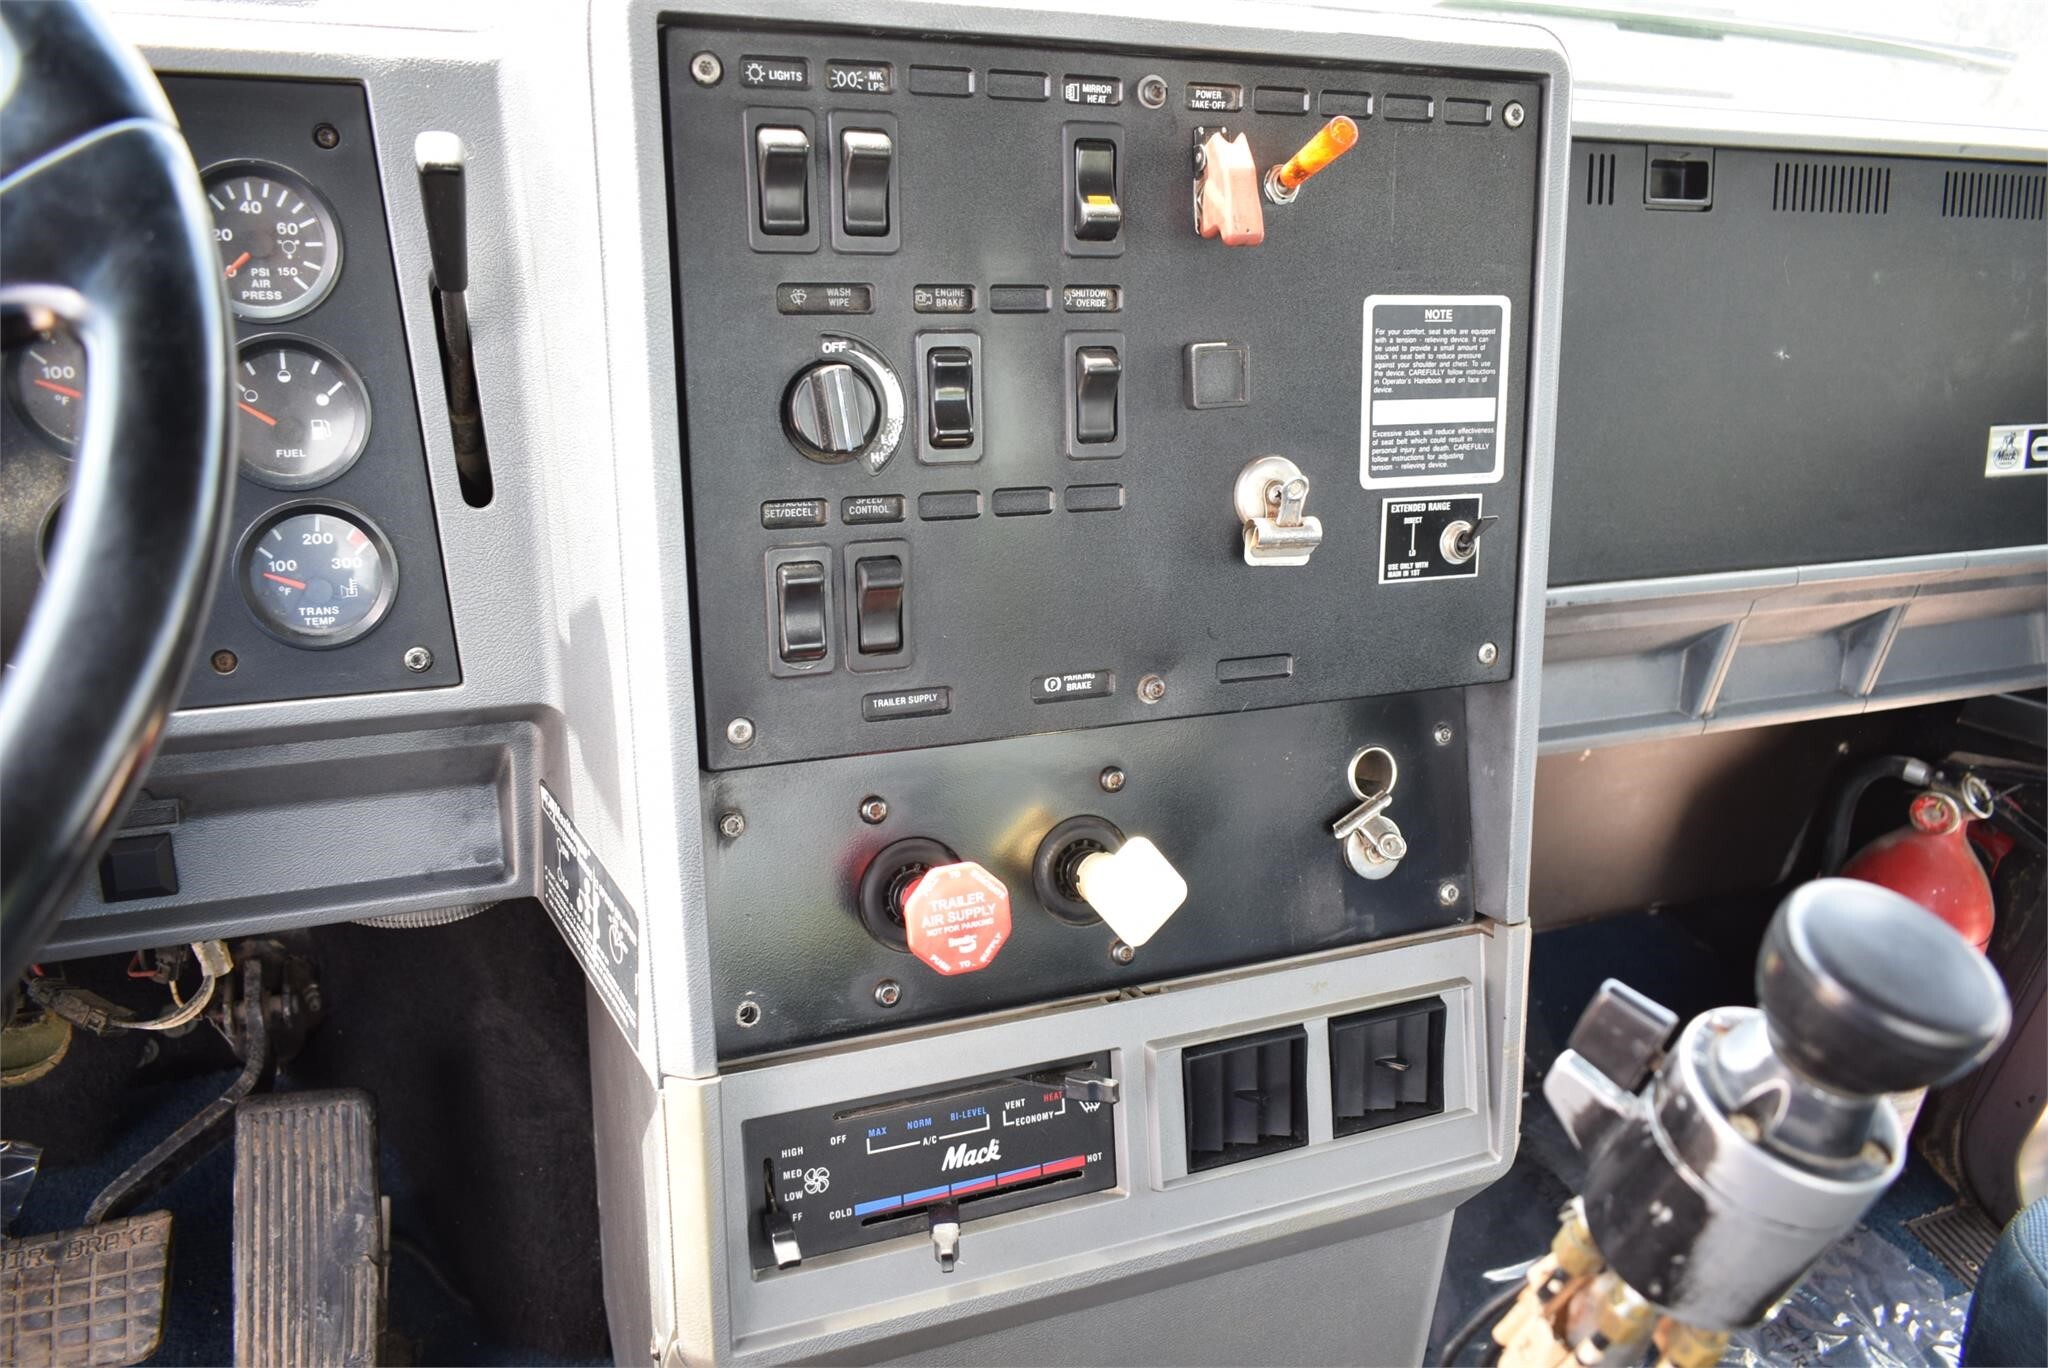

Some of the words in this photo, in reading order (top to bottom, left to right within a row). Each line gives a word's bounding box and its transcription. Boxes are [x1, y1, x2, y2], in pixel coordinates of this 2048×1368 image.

[768, 70, 803, 82] LIGHTS
[869, 71, 883, 81] MK
[868, 82, 886, 92] LPS
[1082, 84, 1112, 94] MIRROR
[1087, 94, 1107, 104] HEAT
[1196, 89, 1222, 100] POWER
[1191, 100, 1226, 110] TAKE-OFF
[239, 201, 262, 214] 40
[212, 229, 233, 241] 20
[276, 223, 298, 235] 60
[250, 268, 270, 277] PSI
[278, 267, 298, 277] 150
[252, 280, 271, 288] AIR
[242, 291, 282, 300] PRESS
[826, 288, 851, 297] WASH
[935, 289, 965, 298] ENGINE
[829, 298, 850, 307] WIPE
[936, 299, 964, 307] BRAKE
[1076, 299, 1107, 308] OVERIDE
[1425, 309, 1453, 320] NOTE
[822, 342, 847, 354] OFF
[42, 366, 75, 379] 100
[1453, 443, 1490, 451] CAREFULLY
[276, 449, 307, 458] FUEL
[849, 506, 889, 515] CONTROL
[1391, 503, 1426, 513] EXTENDED
[1428, 502, 1451, 511] RANGE
[302, 533, 334, 545] 200
[268, 560, 297, 572] 100
[331, 557, 362, 570] 300
[299, 606, 340, 616] TRANS
[304, 617, 336, 626] TEMP
[1066, 681, 1092, 691] BRAKE
[873, 697, 906, 708] TRAILER
[908, 693, 938, 704] SUPPLY
[929, 891, 985, 912] TRAILER
[922, 913, 944, 929] AIR
[948, 903, 996, 923] SUPPLY
[926, 928, 943, 937] NOT
[944, 924, 960, 934] FOR
[961, 918, 994, 929] PARKING
[959, 959, 971, 968] TO
[980, 932, 1002, 963] SUPPLY
[1043, 1090, 1064, 1103] HEAT
[1005, 1098, 1026, 1111] VENT
[950, 1106, 987, 1122] BI-LEVEL
[1015, 1111, 1054, 1127] ECONOMY
[907, 1117, 932, 1131] NORM
[868, 1126, 888, 1138] MAX
[830, 1135, 847, 1146] OFF
[922, 1135, 937, 1147] A/C
[781, 1147, 804, 1159] HIGH
[941, 1139, 1001, 1172] Mack
[1087, 1152, 1103, 1163] HOT
[783, 1168, 803, 1181] MED
[784, 1190, 803, 1202] LOW
[829, 1208, 852, 1221] COLD
[66, 1225, 156, 1260] BRAKE
